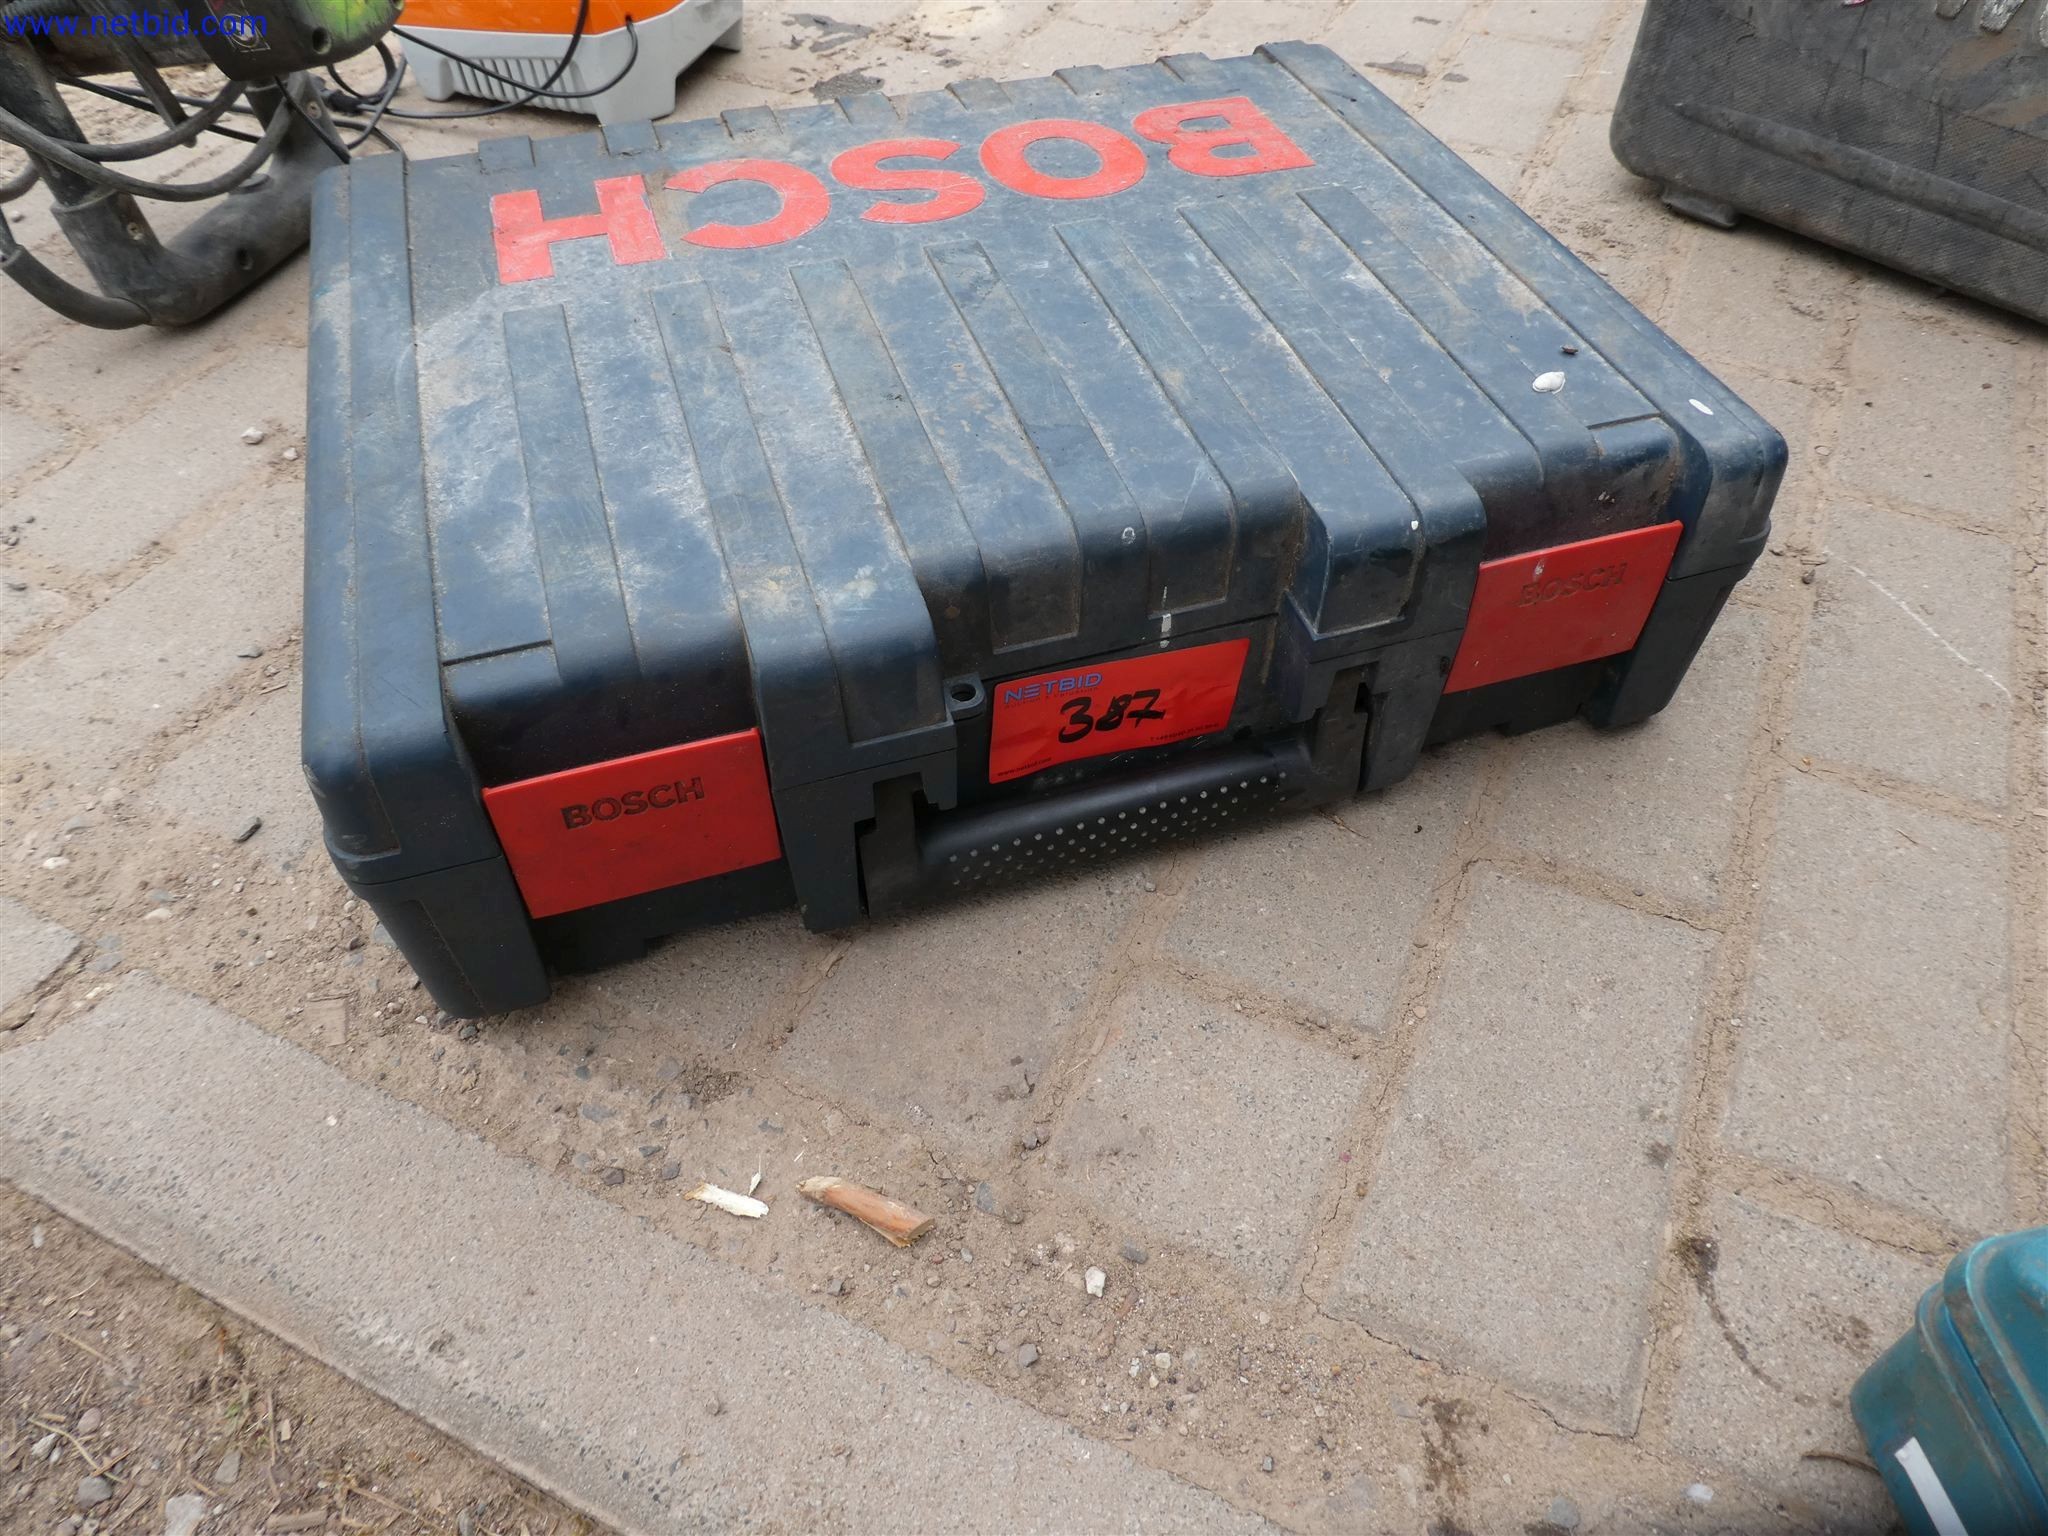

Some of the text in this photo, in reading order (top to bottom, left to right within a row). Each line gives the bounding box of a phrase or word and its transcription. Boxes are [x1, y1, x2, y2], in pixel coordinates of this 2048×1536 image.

[489, 95, 1316, 285] BOSCH
[1517, 562, 1628, 608] BOSCH
[1004, 672, 1103, 704] NETBID
[1058, 688, 1167, 744] 387
[560, 776, 706, 830] BOSCH
